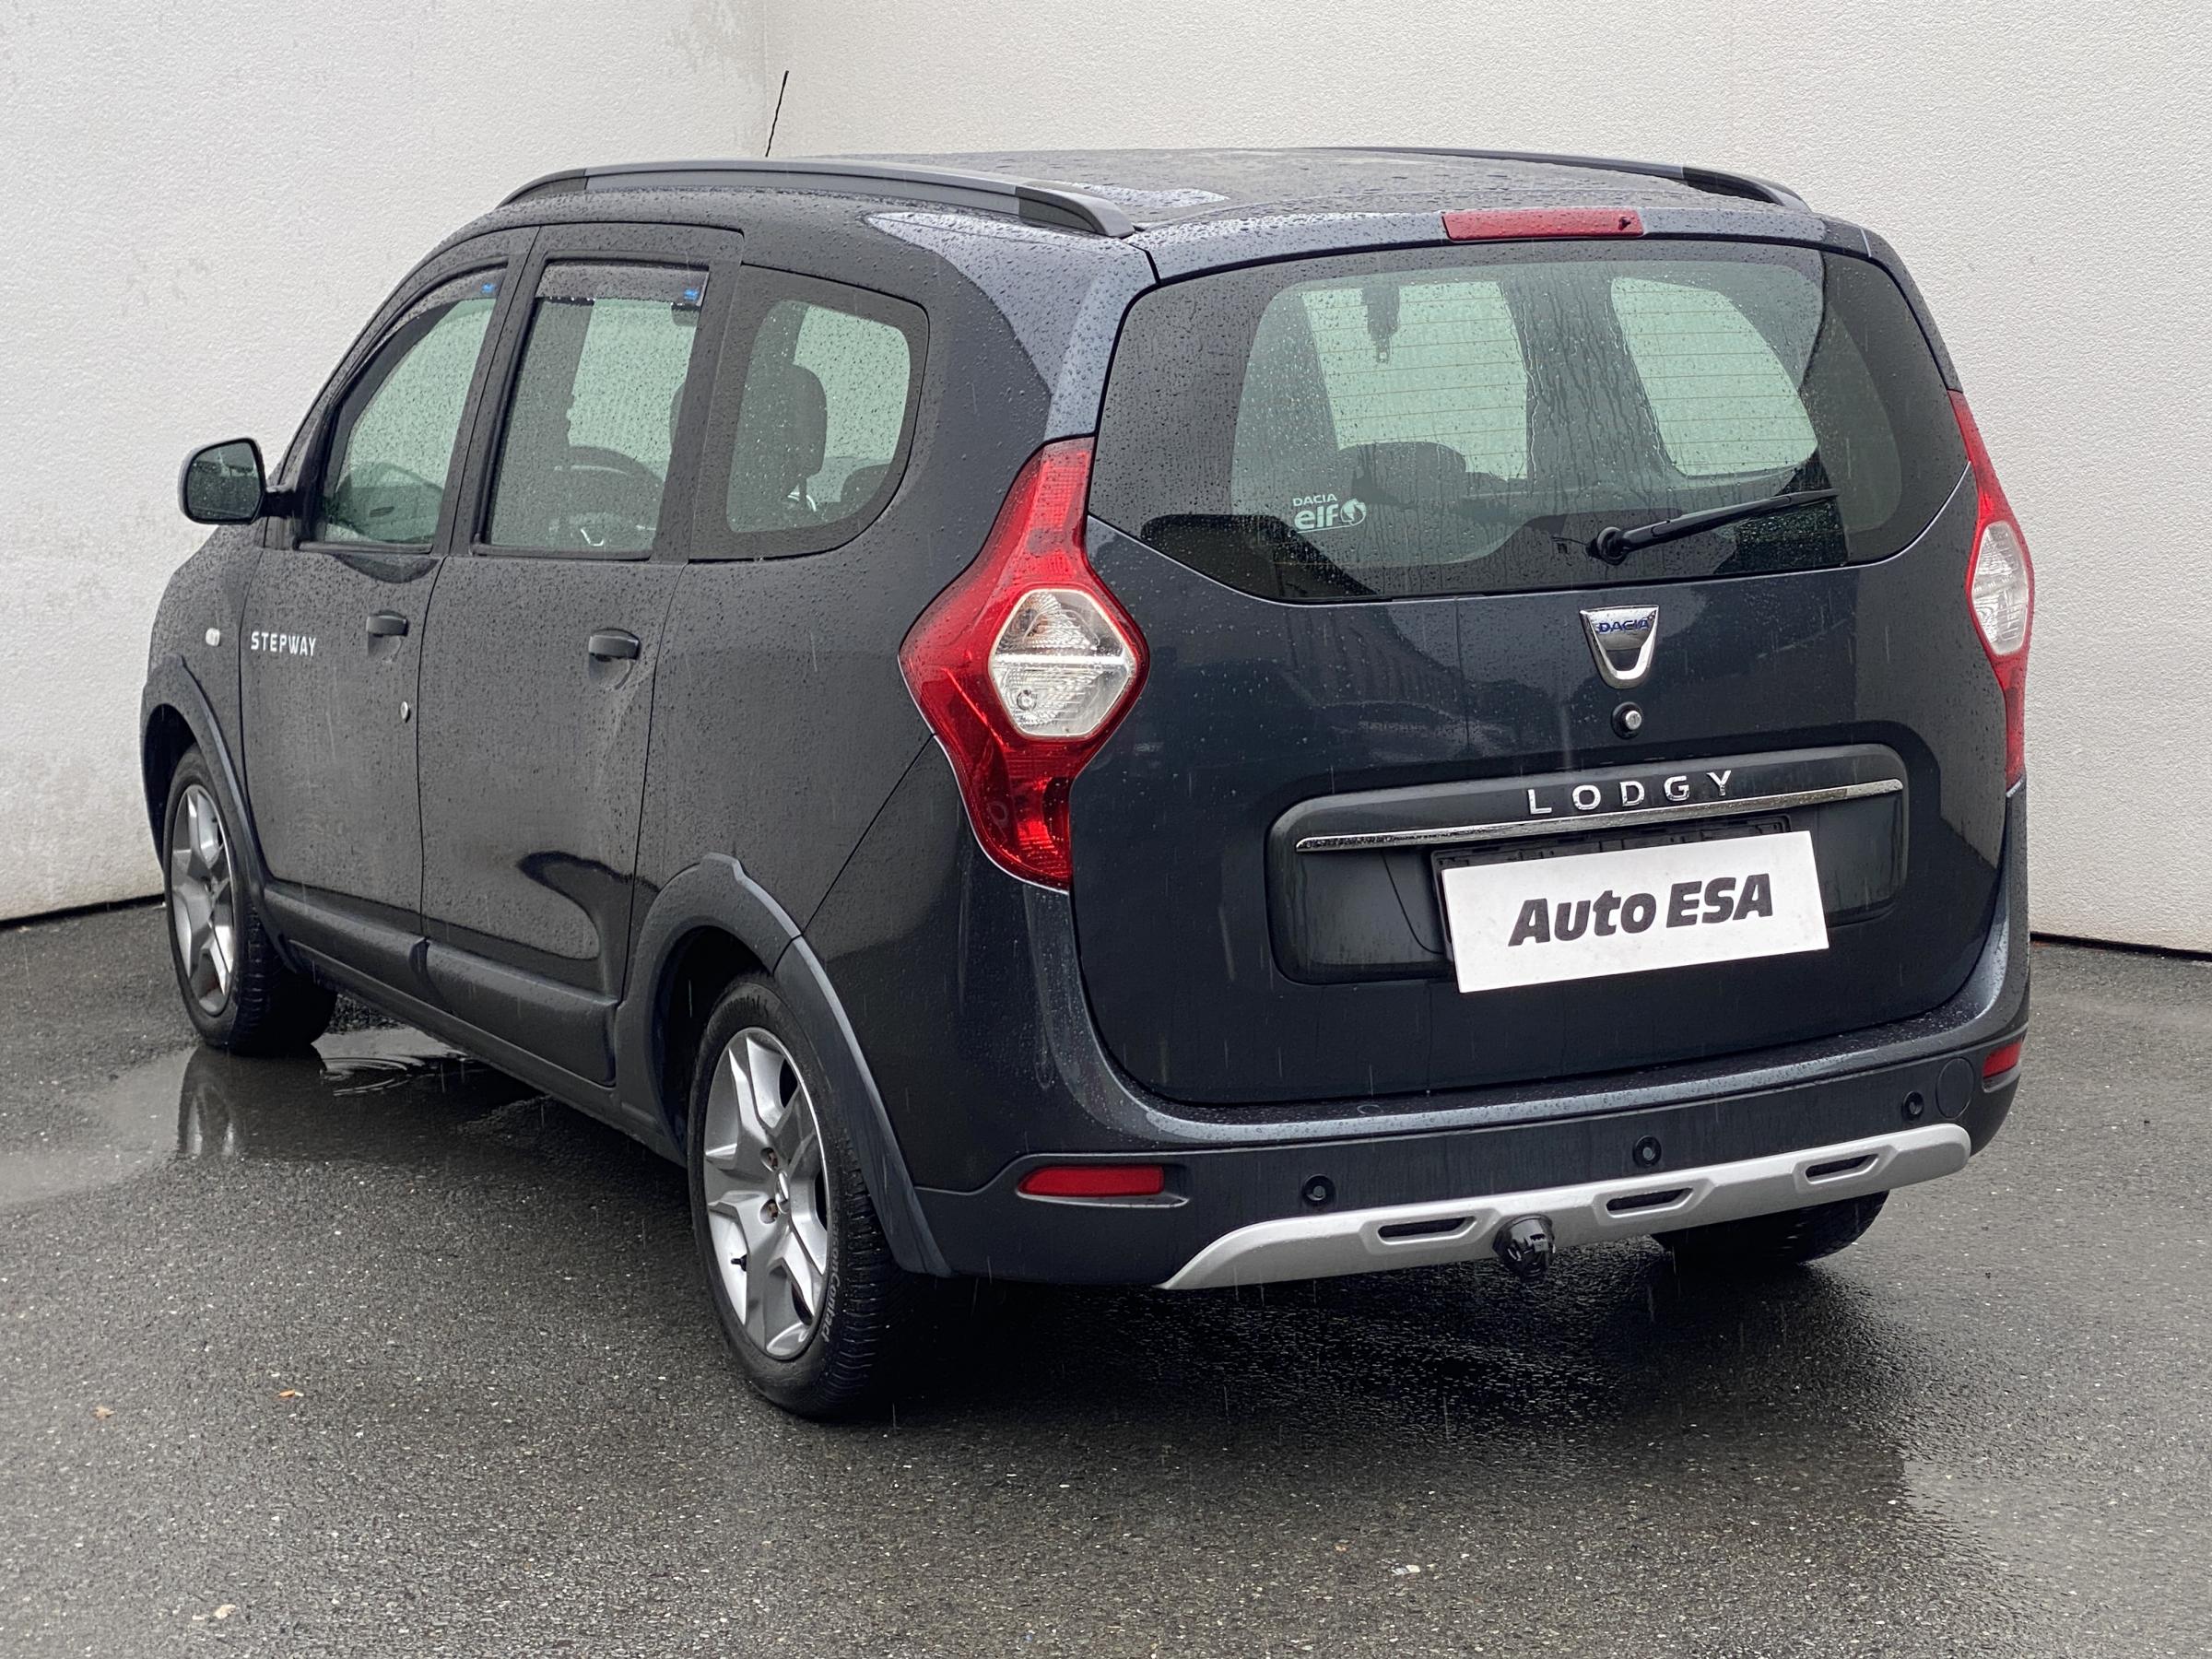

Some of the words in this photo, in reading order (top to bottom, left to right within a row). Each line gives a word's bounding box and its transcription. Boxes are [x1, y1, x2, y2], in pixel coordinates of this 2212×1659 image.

[1292, 493, 1338, 507] DACIA
[1294, 503, 1339, 530] elf
[1597, 618, 1651, 634] DACIA
[250, 630, 317, 657] STEPWAY
[1526, 769, 1732, 815] LODGY
[1508, 889, 1657, 947] Auto
[1665, 873, 1773, 928] ESA
